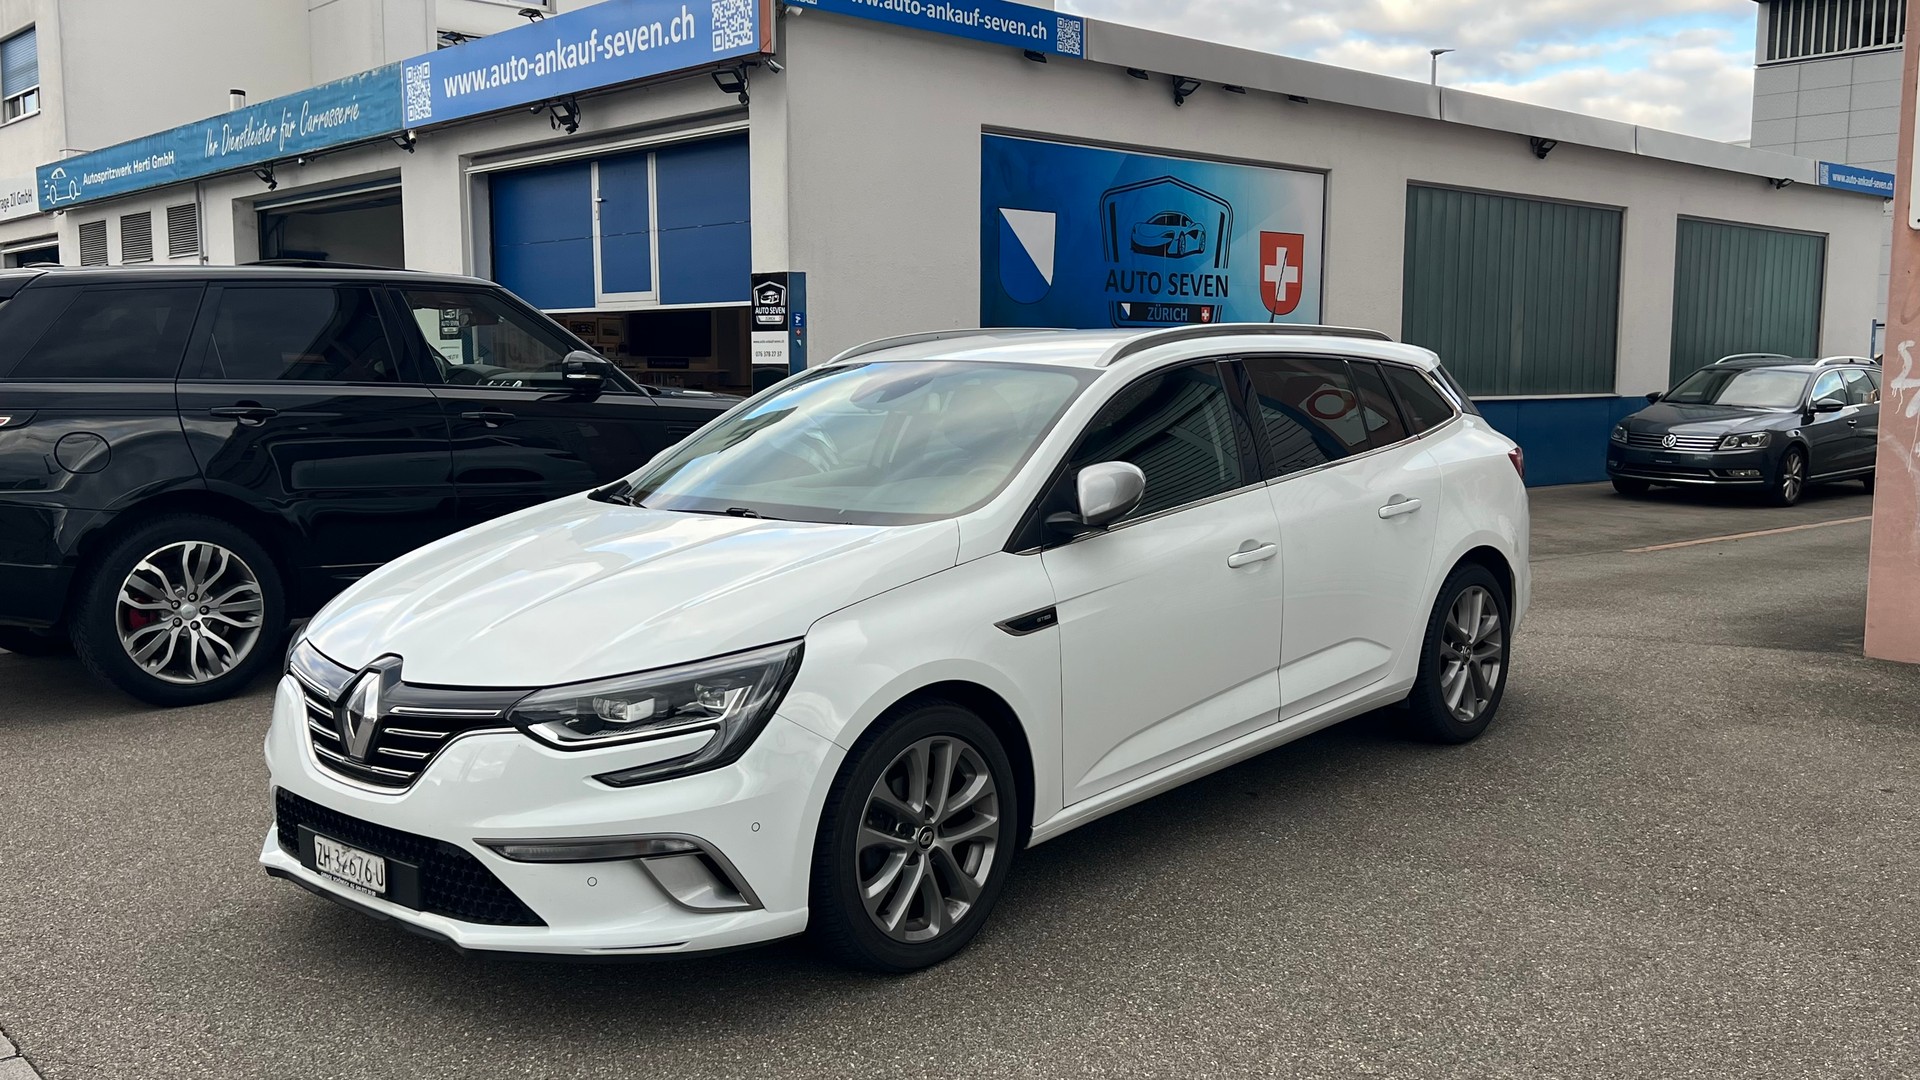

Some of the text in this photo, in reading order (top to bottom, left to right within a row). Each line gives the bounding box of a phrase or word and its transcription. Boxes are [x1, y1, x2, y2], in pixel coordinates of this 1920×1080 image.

[443, 4, 695, 98] www.auto-ankauf-seven.ch
[204, 95, 360, 158] Ihr Dienstleister für Carrosserie
[83, 150, 175, 185] Autospritzwerk Herti GmbH
[17, 188, 33, 205] GmbH
[1104, 268, 1229, 298] AUTO SEVEN
[755, 306, 786, 314] AUTO SEVEN
[1146, 304, 1189, 322] ZÜRICH
